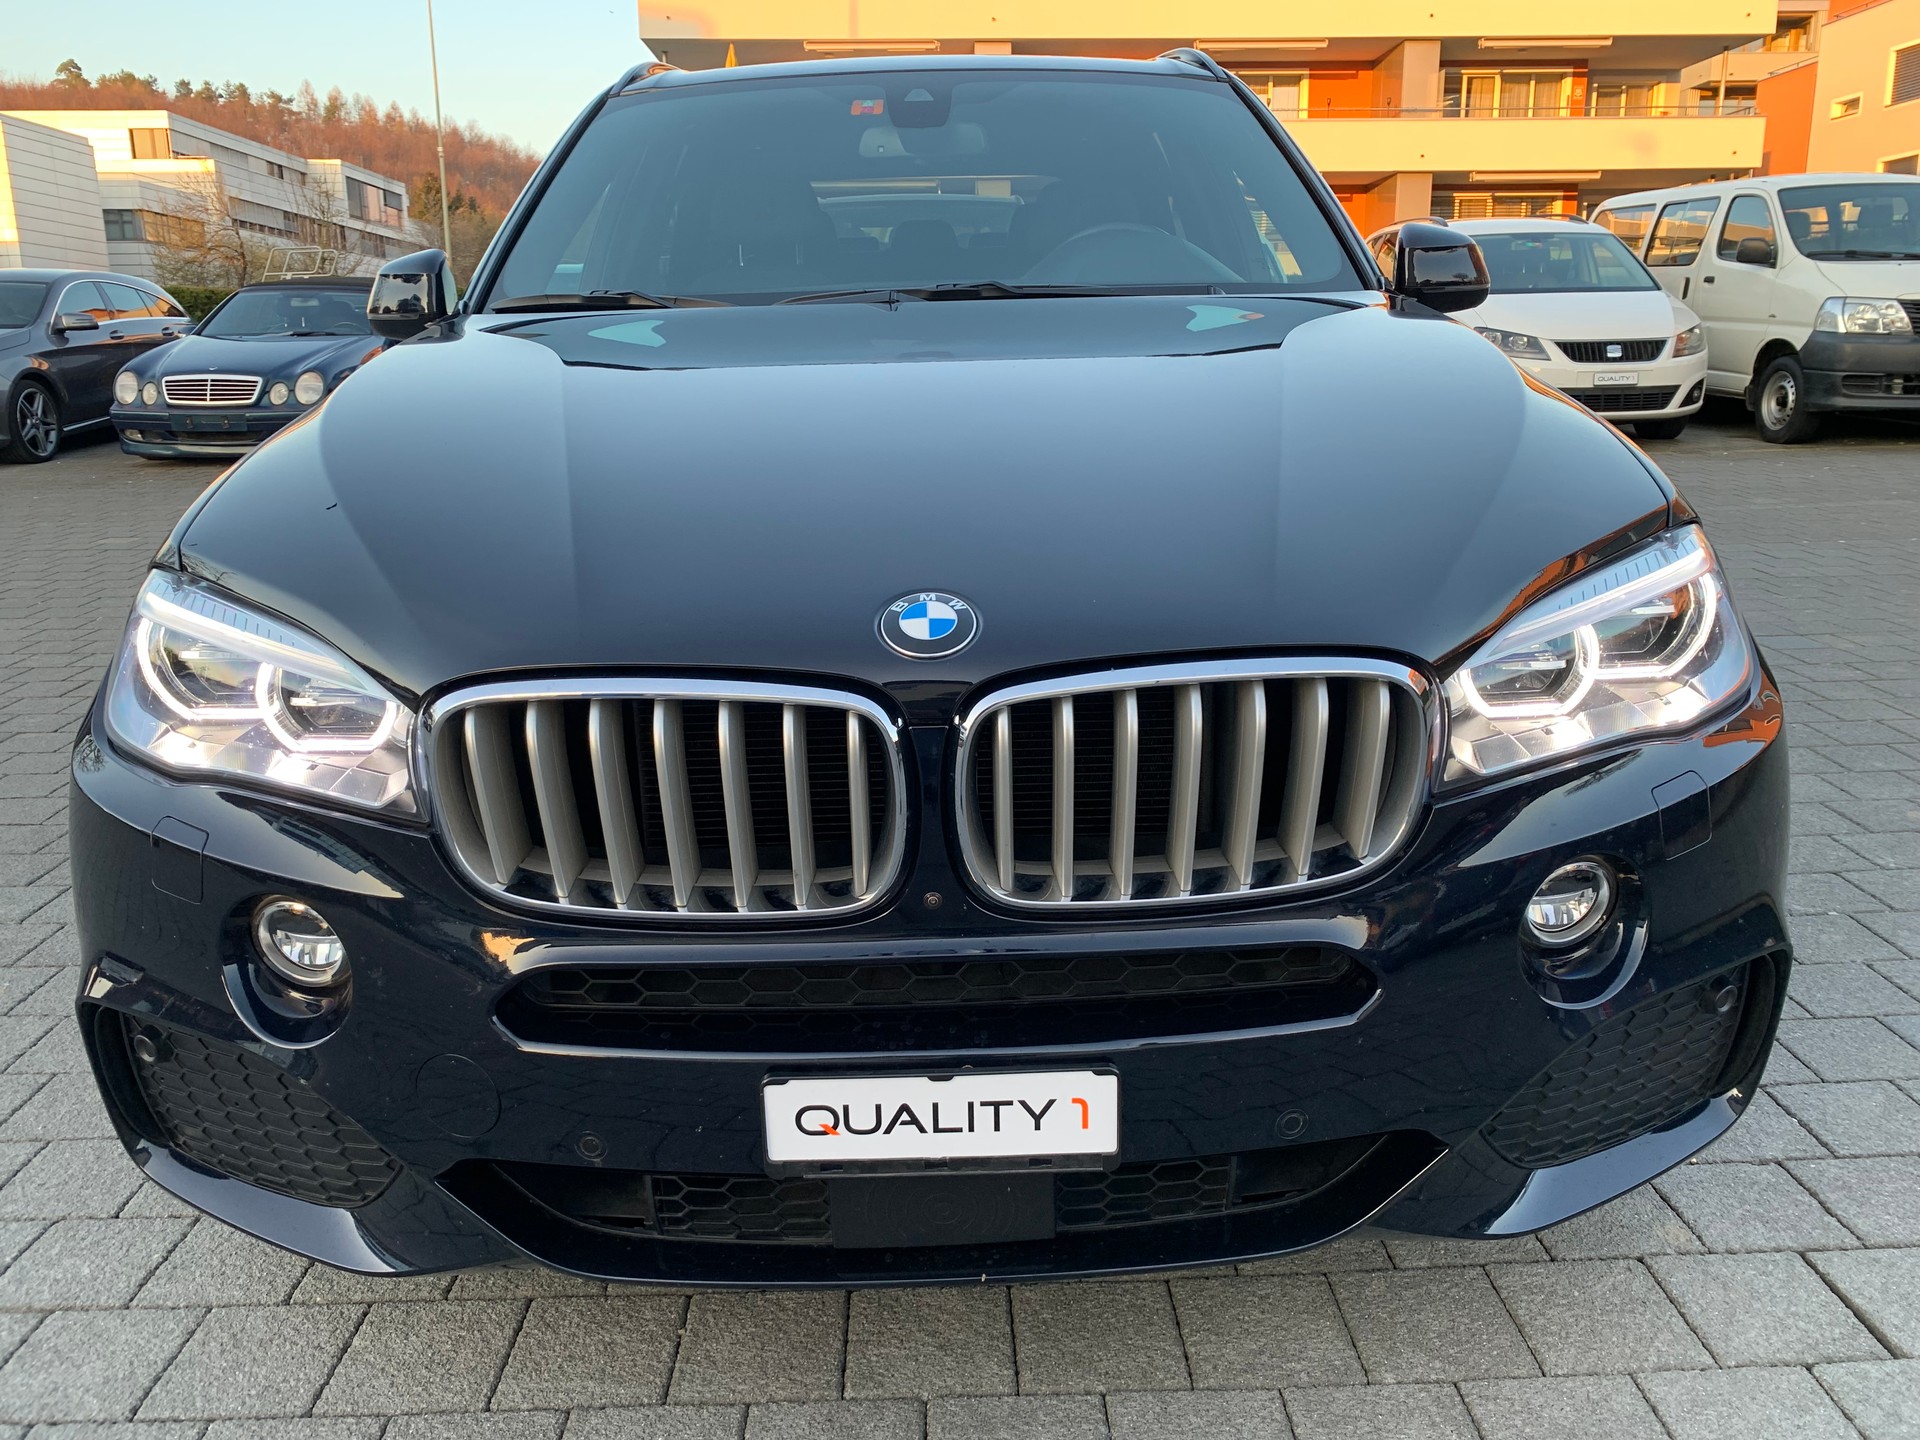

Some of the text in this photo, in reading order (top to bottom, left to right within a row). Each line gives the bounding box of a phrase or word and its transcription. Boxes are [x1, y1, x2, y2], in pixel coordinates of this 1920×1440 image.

[891, 594, 966, 612] BMW
[795, 1097, 1089, 1136] QUALITY 1
